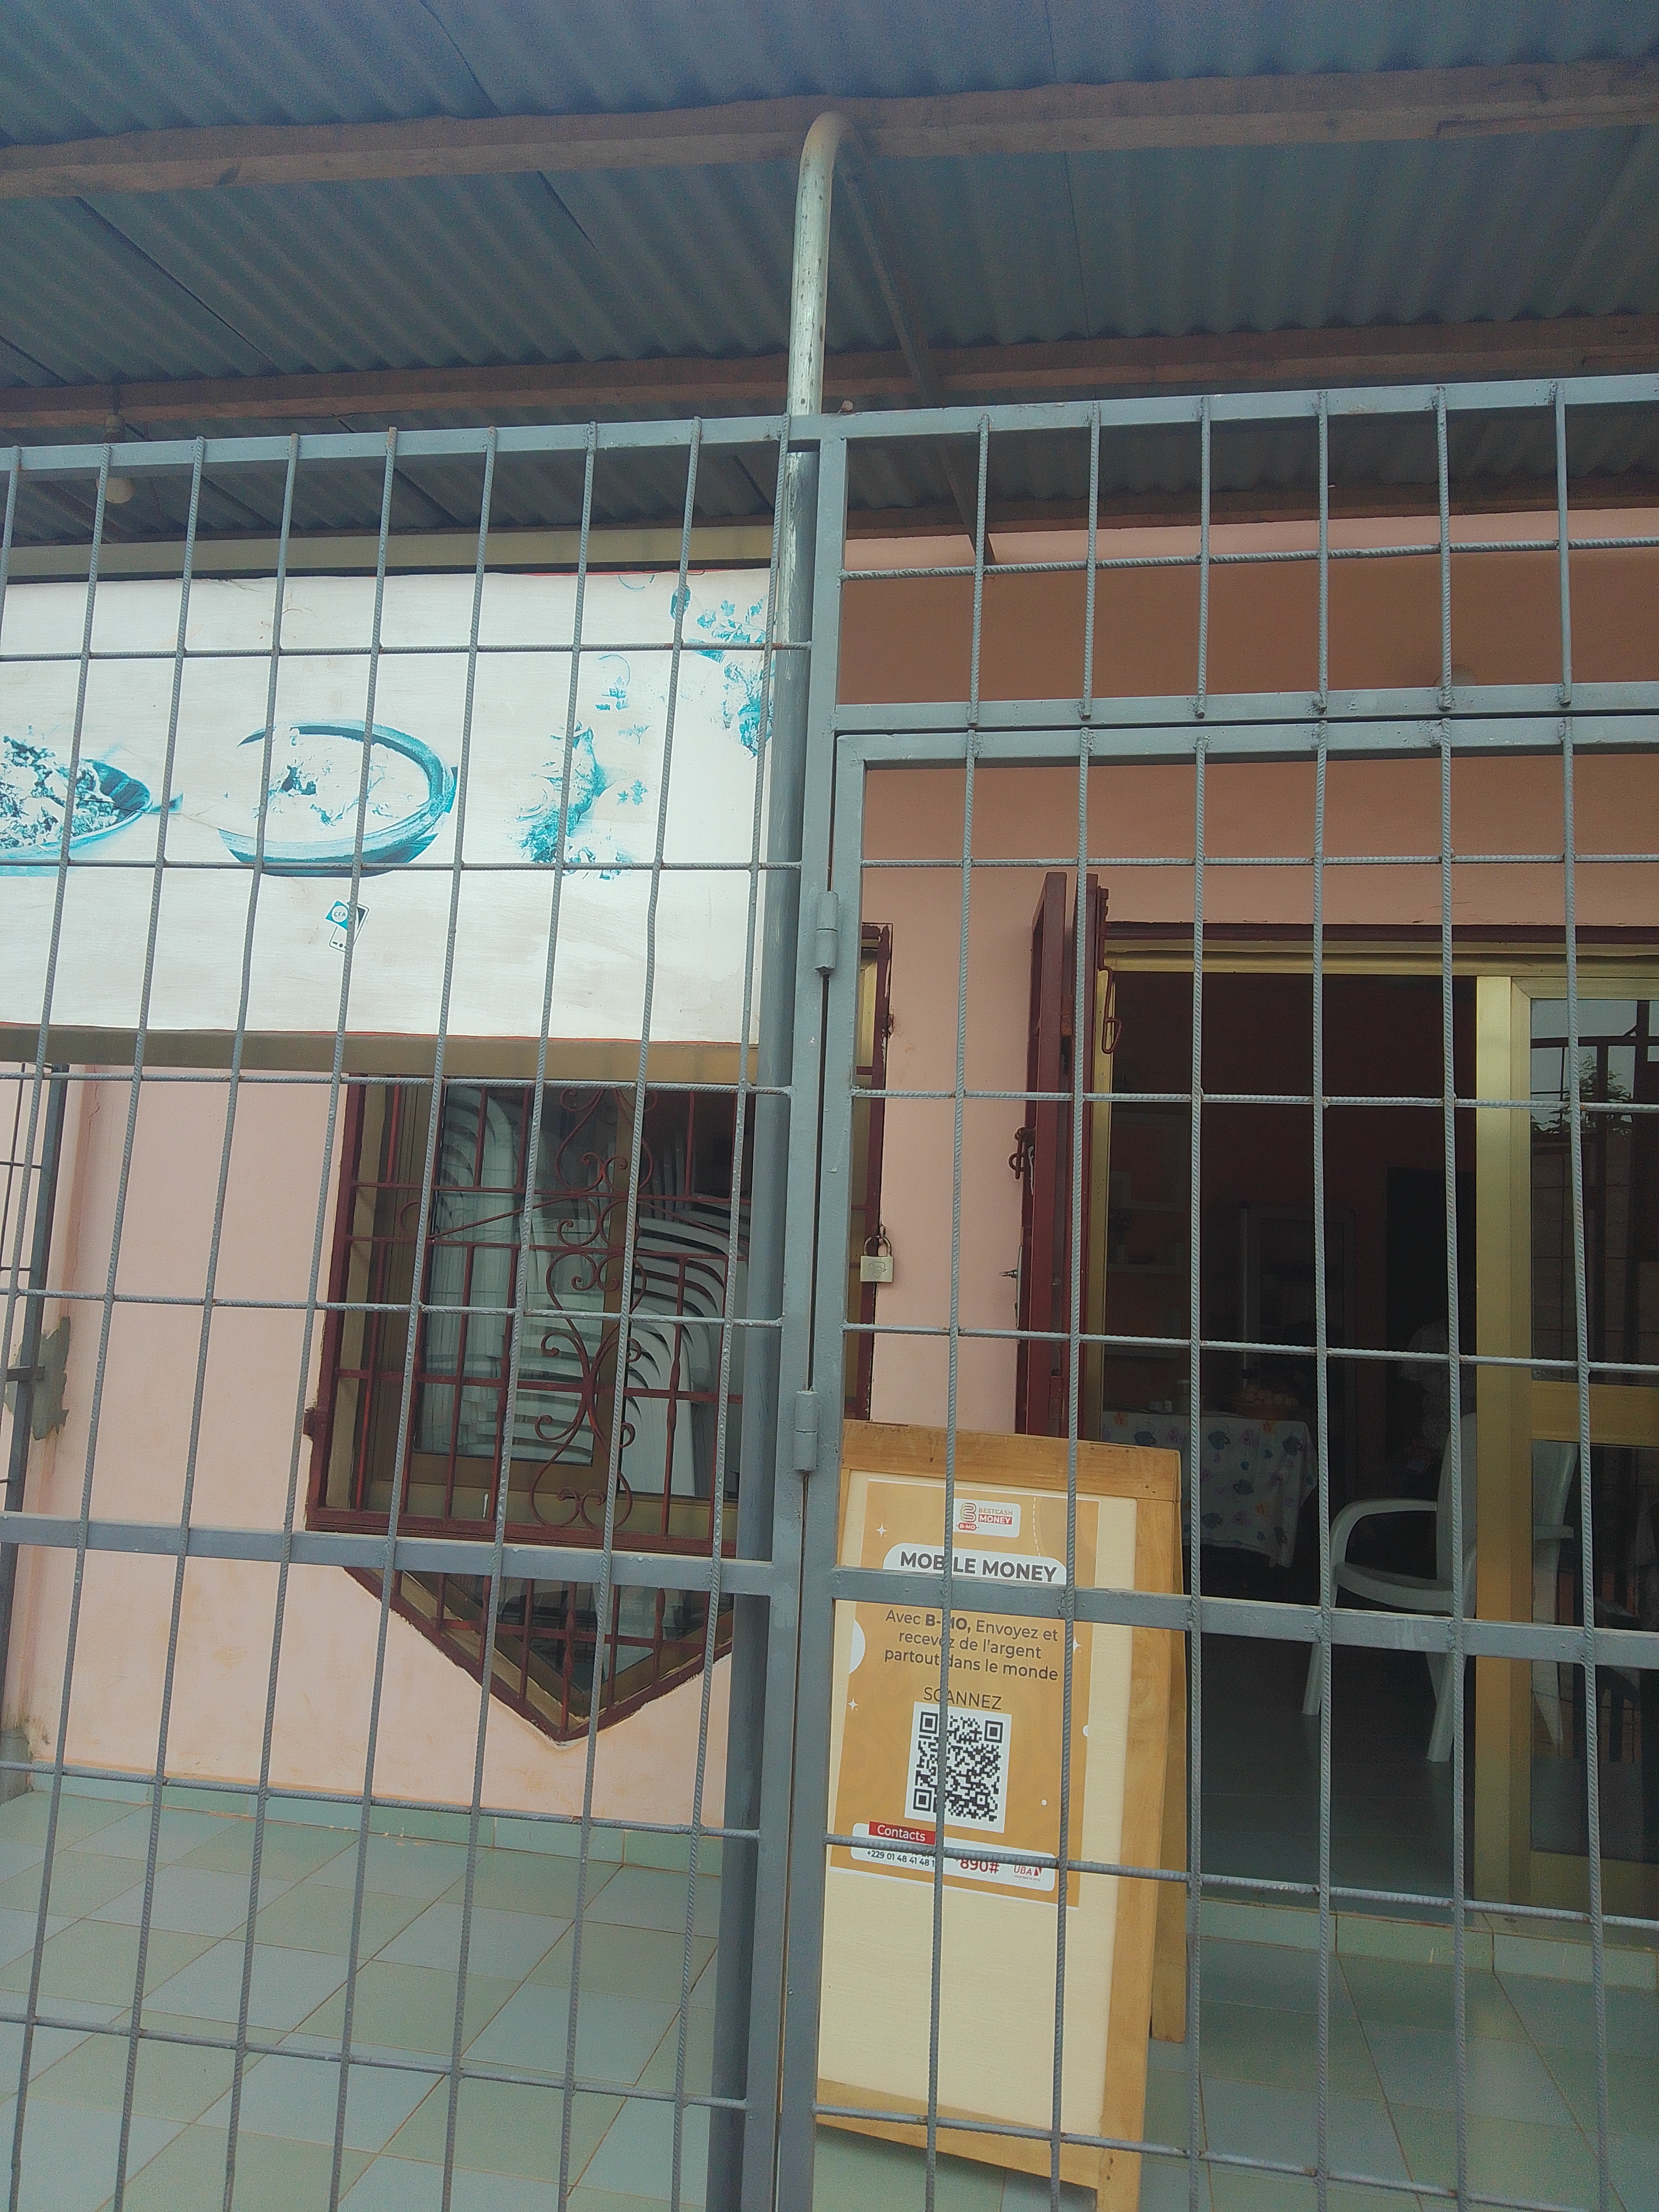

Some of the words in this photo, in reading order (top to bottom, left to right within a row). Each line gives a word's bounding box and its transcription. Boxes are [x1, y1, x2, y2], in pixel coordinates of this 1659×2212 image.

[979, 1507, 1013, 1516] BESTCASH
[979, 1515, 1011, 1524] MONEY
[900, 1551, 976, 1574] MOBLE
[982, 1560, 1057, 1582] MONEY
[885, 1610, 921, 1625] Avec
[976, 1620, 1038, 1639] Envoyez
[1043, 1629, 1059, 1642] et
[959, 1636, 978, 1651] de
[884, 1649, 940, 1666] partout
[948, 1654, 981, 1671] dans
[985, 1658, 999, 1673] le
[1003, 1664, 1059, 1681] monde
[923, 1687, 1002, 1711] SCANNEZ
[877, 1825, 926, 1842] Contacts
[867, 1850, 885, 1859] +229
[896, 1854, 907, 1863] 48
[909, 1856, 917, 1865] 41
[1013, 1865, 1032, 1876] UBA
